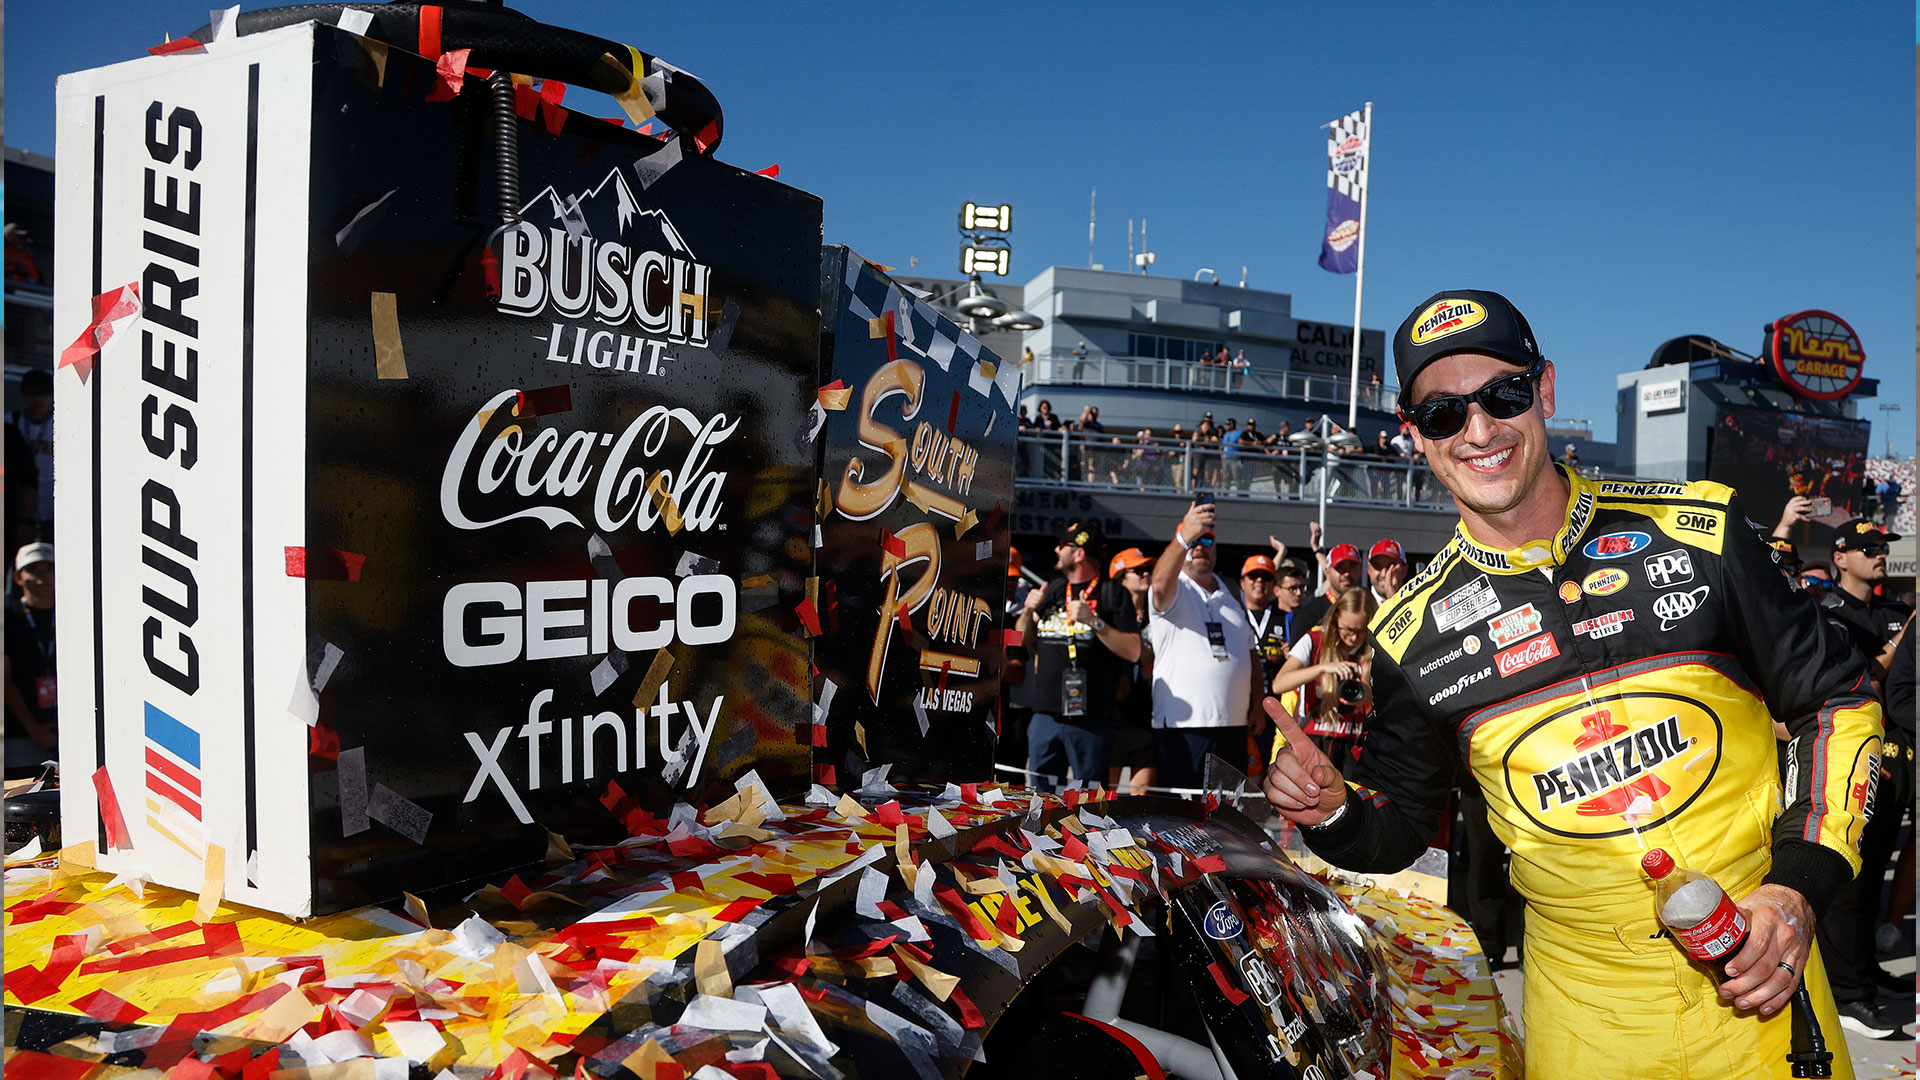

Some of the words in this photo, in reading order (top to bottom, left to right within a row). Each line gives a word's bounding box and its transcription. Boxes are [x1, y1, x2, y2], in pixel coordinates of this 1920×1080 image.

[141, 101, 203, 471] SERIES
[496, 216, 711, 348] BUSCH
[1417, 303, 1476, 338] PENNZOIL
[545, 322, 668, 376] LIGHT
[1796, 359, 1847, 379] GARAGE
[836, 358, 978, 521] SOUTH
[440, 388, 741, 532] Coca-Cola
[1600, 482, 1686, 496] PENNZOIL
[1560, 490, 1595, 554] PENNZOIL
[1677, 513, 1717, 532] OMP
[1454, 526, 1511, 570] PENNZOIL
[1400, 547, 1452, 598] PENNZOIL
[1588, 573, 1621, 591] PENNZOIL
[1647, 555, 1690, 584] PPG
[142, 477, 200, 696] CUP
[1451, 580, 1482, 605] NASCAR
[866, 522, 993, 707] POINT
[1445, 607, 1461, 622] CUP
[1461, 593, 1488, 614] SERIES
[1460, 609, 1488, 628] CHAMPION
[1498, 611, 1524, 627] HUNT
[1658, 592, 1694, 616] AAA
[443, 574, 737, 667] GEICO
[1387, 609, 1414, 640] OMP
[1492, 614, 1537, 638] BROTHERS
[1504, 624, 1530, 640] PIZZA
[1573, 609, 1635, 635] DISCOUNT
[1591, 624, 1619, 638] TIRE
[1418, 647, 1463, 678] Autotrader
[1500, 635, 1552, 673] Coca-Cola
[920, 686, 940, 710] LAS
[942, 689, 973, 713] VEGAS
[1428, 666, 1493, 706] GOODYEAR
[461, 679, 725, 824] xfinity
[1532, 716, 1689, 811] PENNZOIL
[1212, 904, 1240, 935] Ford
[1246, 957, 1276, 998] PPG
